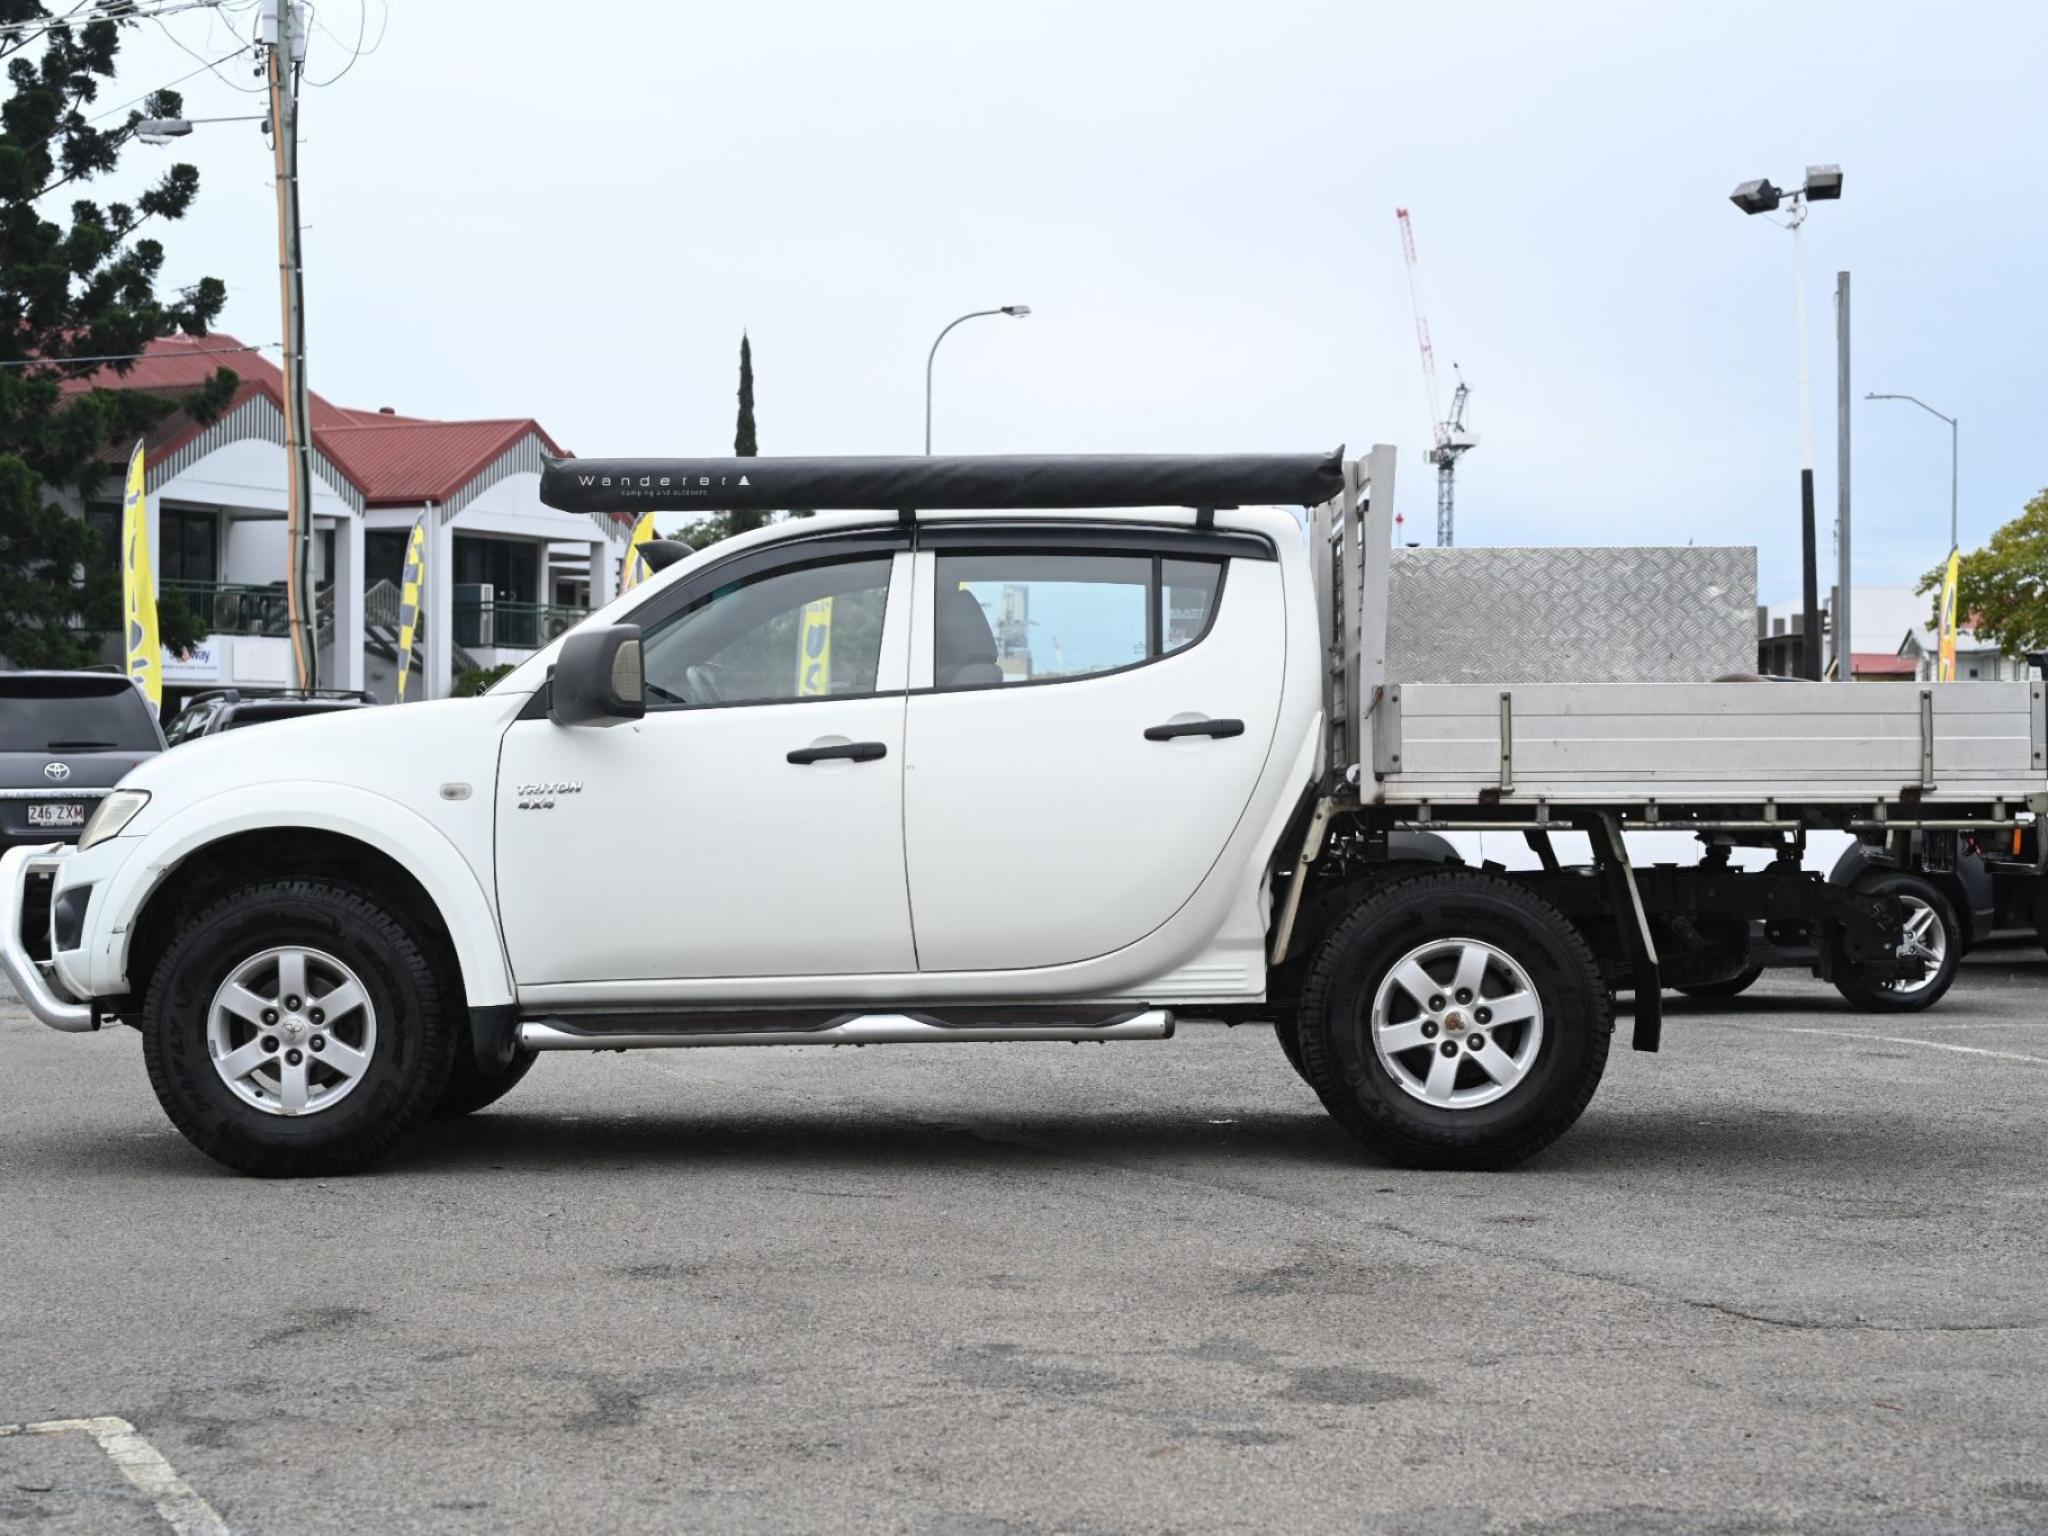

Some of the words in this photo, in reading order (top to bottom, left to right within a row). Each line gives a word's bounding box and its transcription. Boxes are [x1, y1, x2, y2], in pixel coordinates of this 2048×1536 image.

[578, 475, 727, 487] Wanderer
[517, 781, 583, 796] TRITON
[30, 806, 53, 820] 246
[57, 806, 83, 820] ZXM
